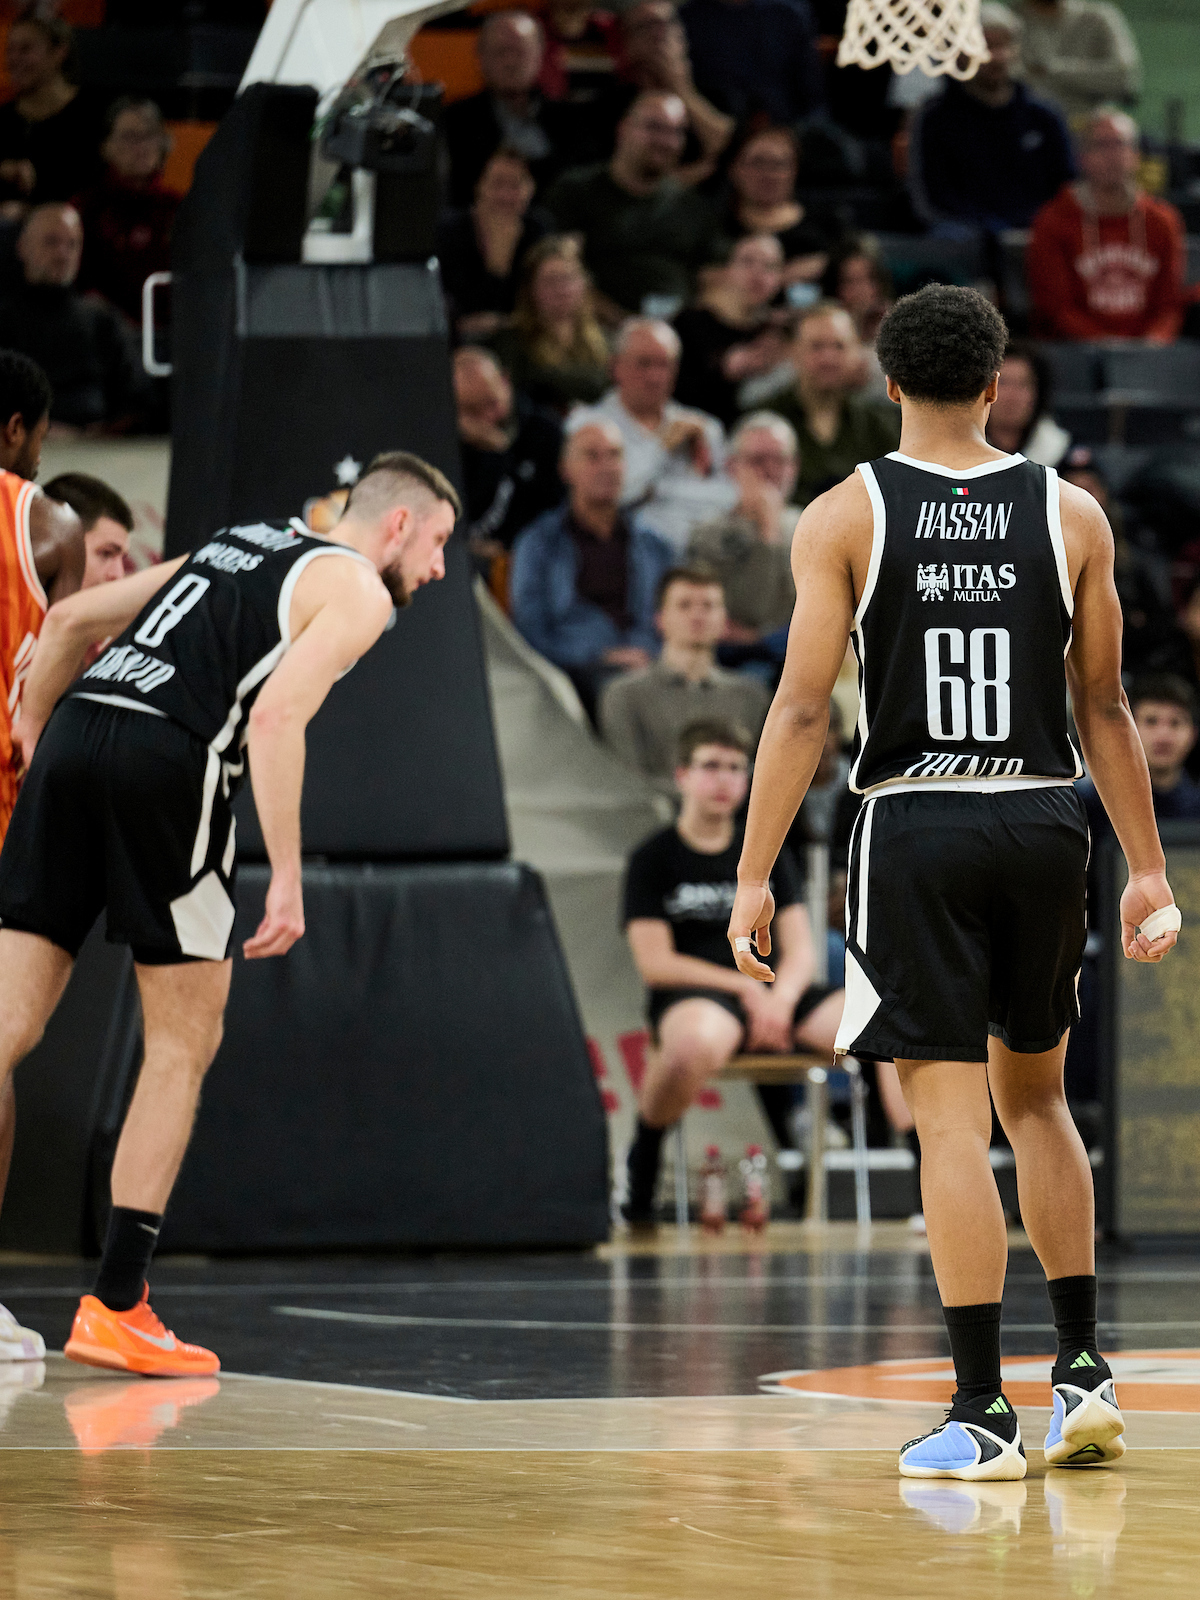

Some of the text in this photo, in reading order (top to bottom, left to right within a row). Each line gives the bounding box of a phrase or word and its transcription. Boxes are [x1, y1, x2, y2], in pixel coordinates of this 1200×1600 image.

[914, 501, 1013, 540] HASSAN
[952, 563, 1017, 589] ITAS
[134, 572, 210, 648] 8
[952, 590, 1001, 602] MUTUA
[924, 627, 1011, 741] 68
[902, 752, 1024, 778] TRENTO
